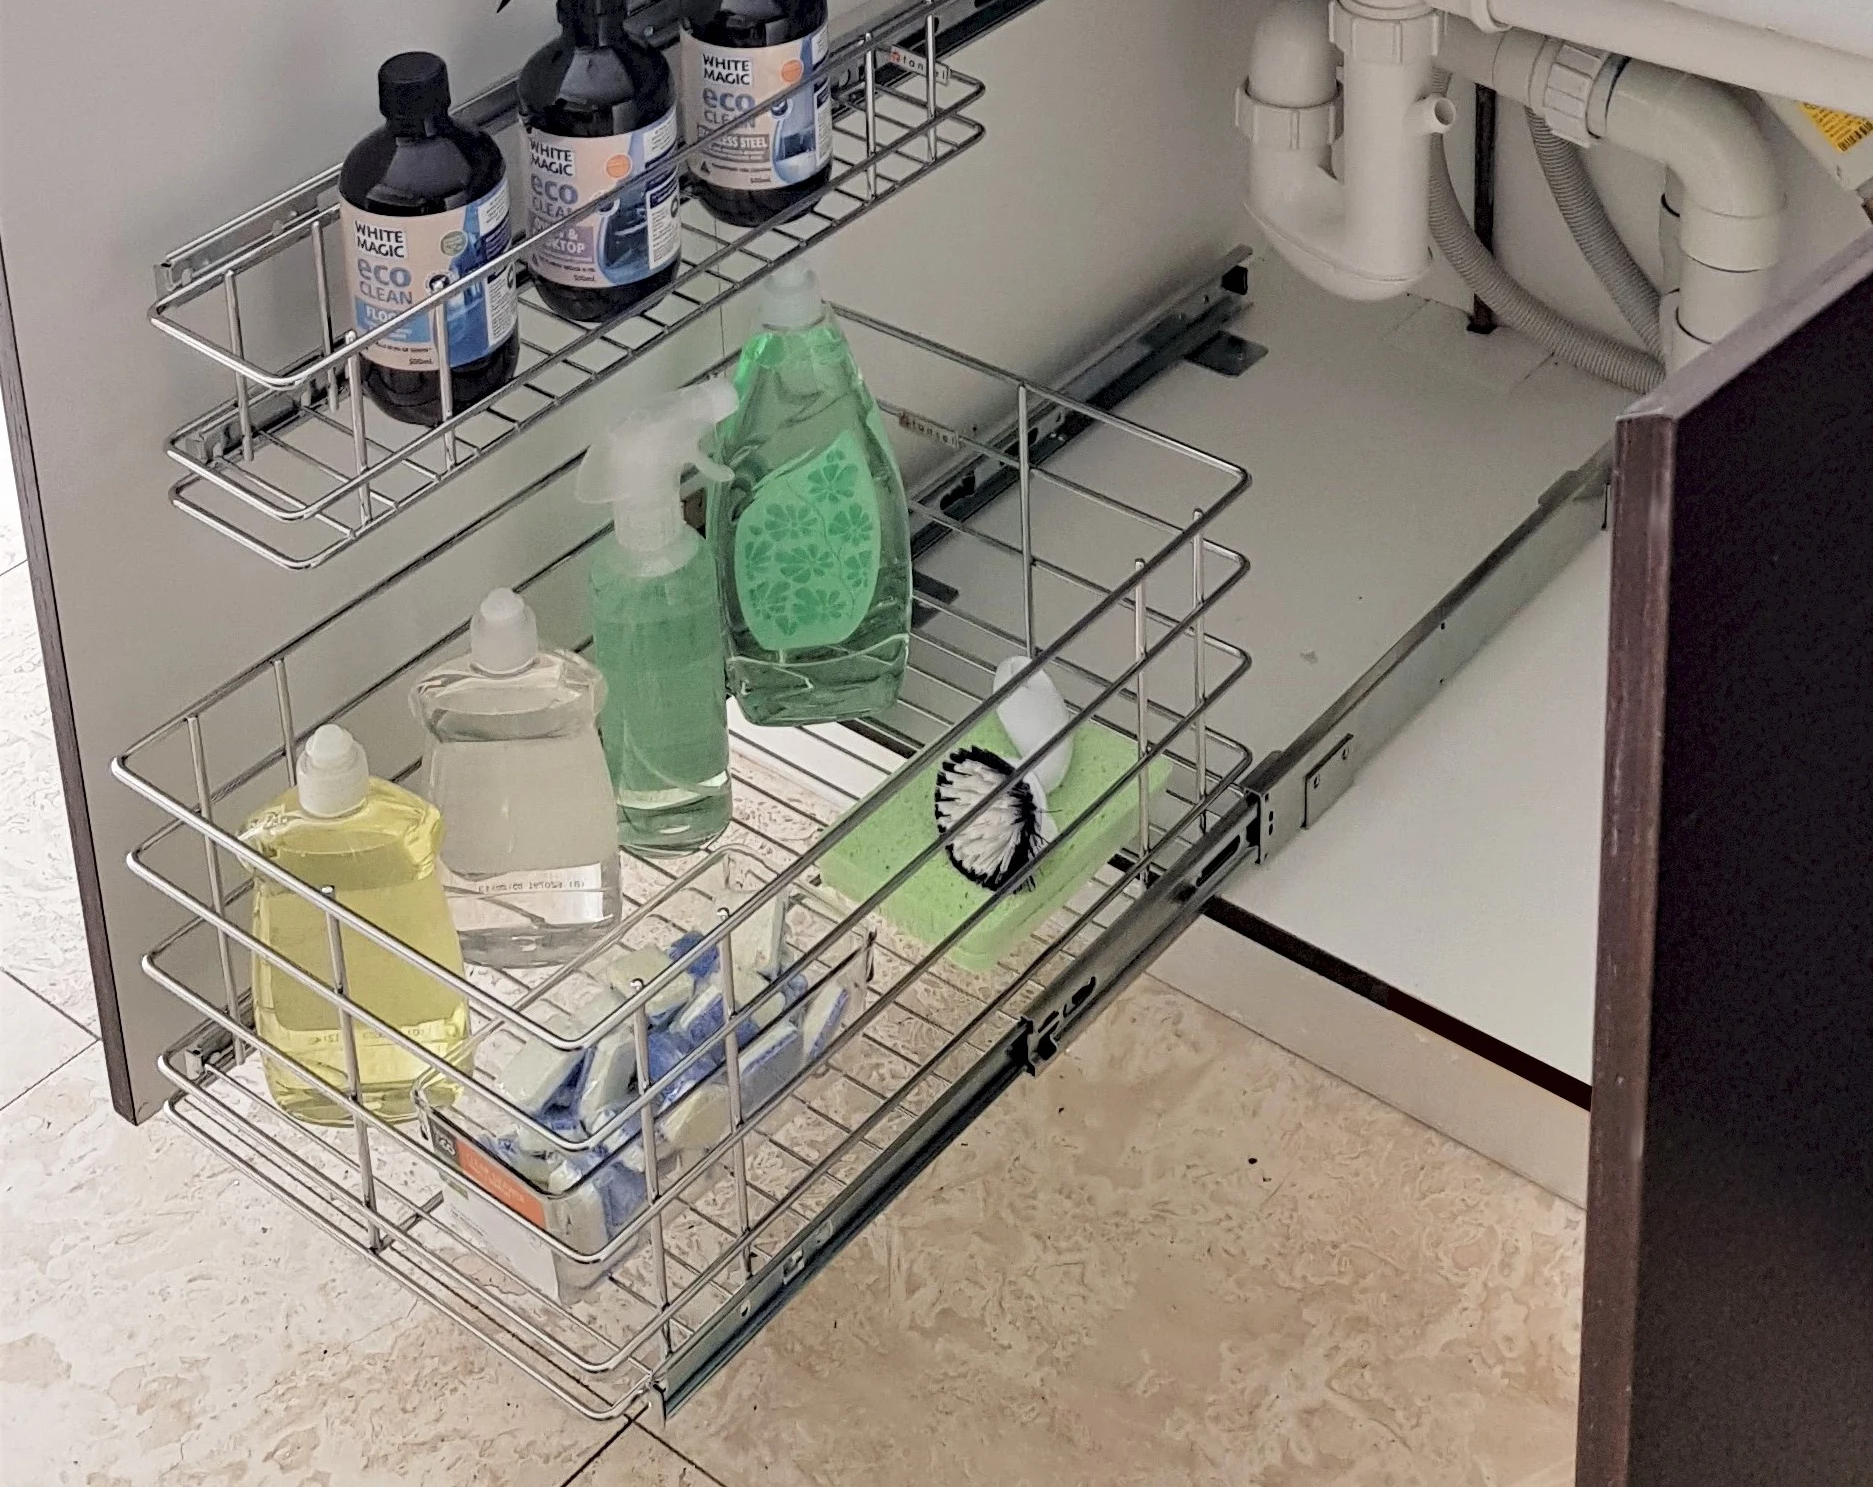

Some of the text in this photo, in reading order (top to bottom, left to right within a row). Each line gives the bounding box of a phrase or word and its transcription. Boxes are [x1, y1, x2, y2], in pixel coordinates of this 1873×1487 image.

[703, 54, 750, 72] WHITE
[703, 68, 751, 86] MAGIC
[702, 87, 755, 112] eco
[529, 137, 573, 163] WHITE
[739, 136, 769, 148] STEEL
[529, 154, 574, 176] MAGIC
[530, 172, 579, 204] eco
[354, 220, 403, 244] WHITE
[356, 235, 405, 258] MAGIC
[357, 258, 412, 288] eco
[359, 280, 413, 305] CLEAN
